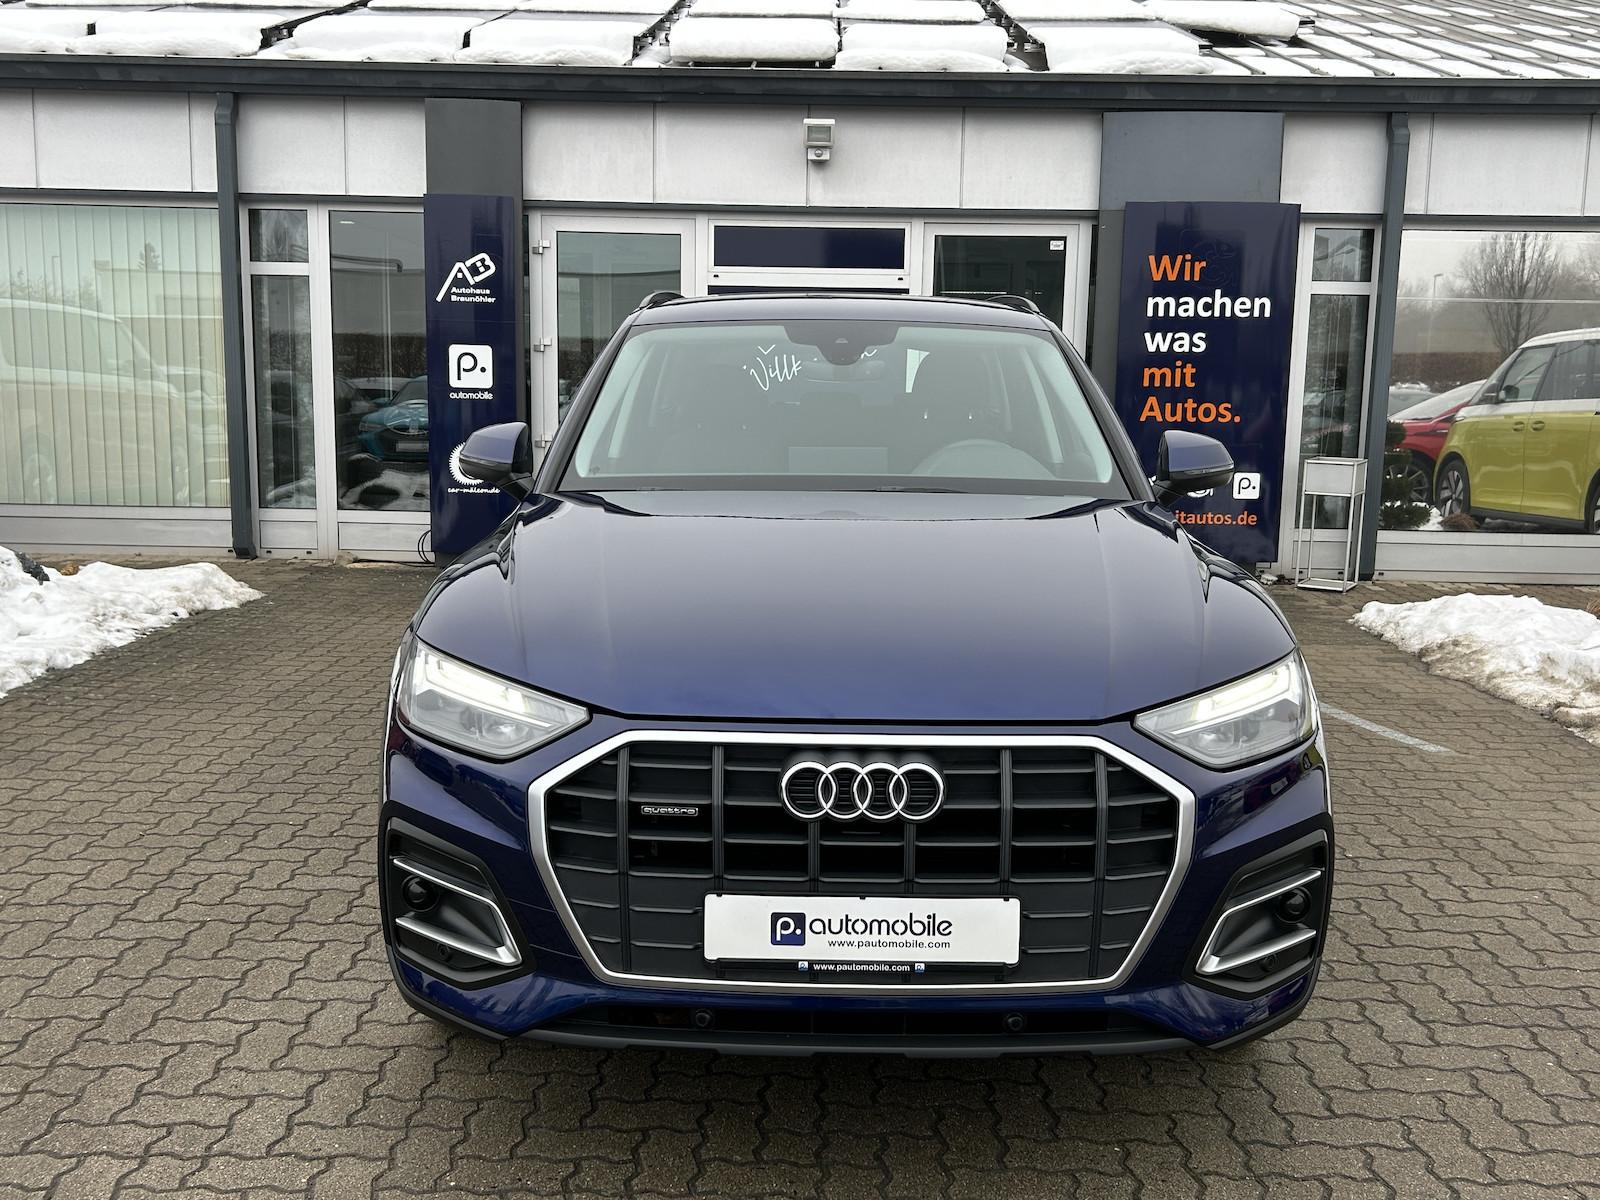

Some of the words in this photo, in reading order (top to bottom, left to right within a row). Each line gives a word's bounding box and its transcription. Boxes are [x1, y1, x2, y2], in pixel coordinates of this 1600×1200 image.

[1148, 254, 1206, 281] Wir
[450, 287, 490, 295] Autohaus
[450, 295, 496, 303] Braunöhler
[1146, 289, 1271, 318] machen
[1143, 332, 1207, 353] was
[457, 352, 487, 381] p.
[1142, 360, 1196, 387] mit
[449, 391, 494, 400] automobile
[1139, 396, 1241, 423] Autos.
[643, 807, 697, 815] quattro
[809, 912, 953, 937] automobile
[828, 939, 951, 949] www.pautomobile.com
[813, 963, 910, 972] www.pautomobile.com
